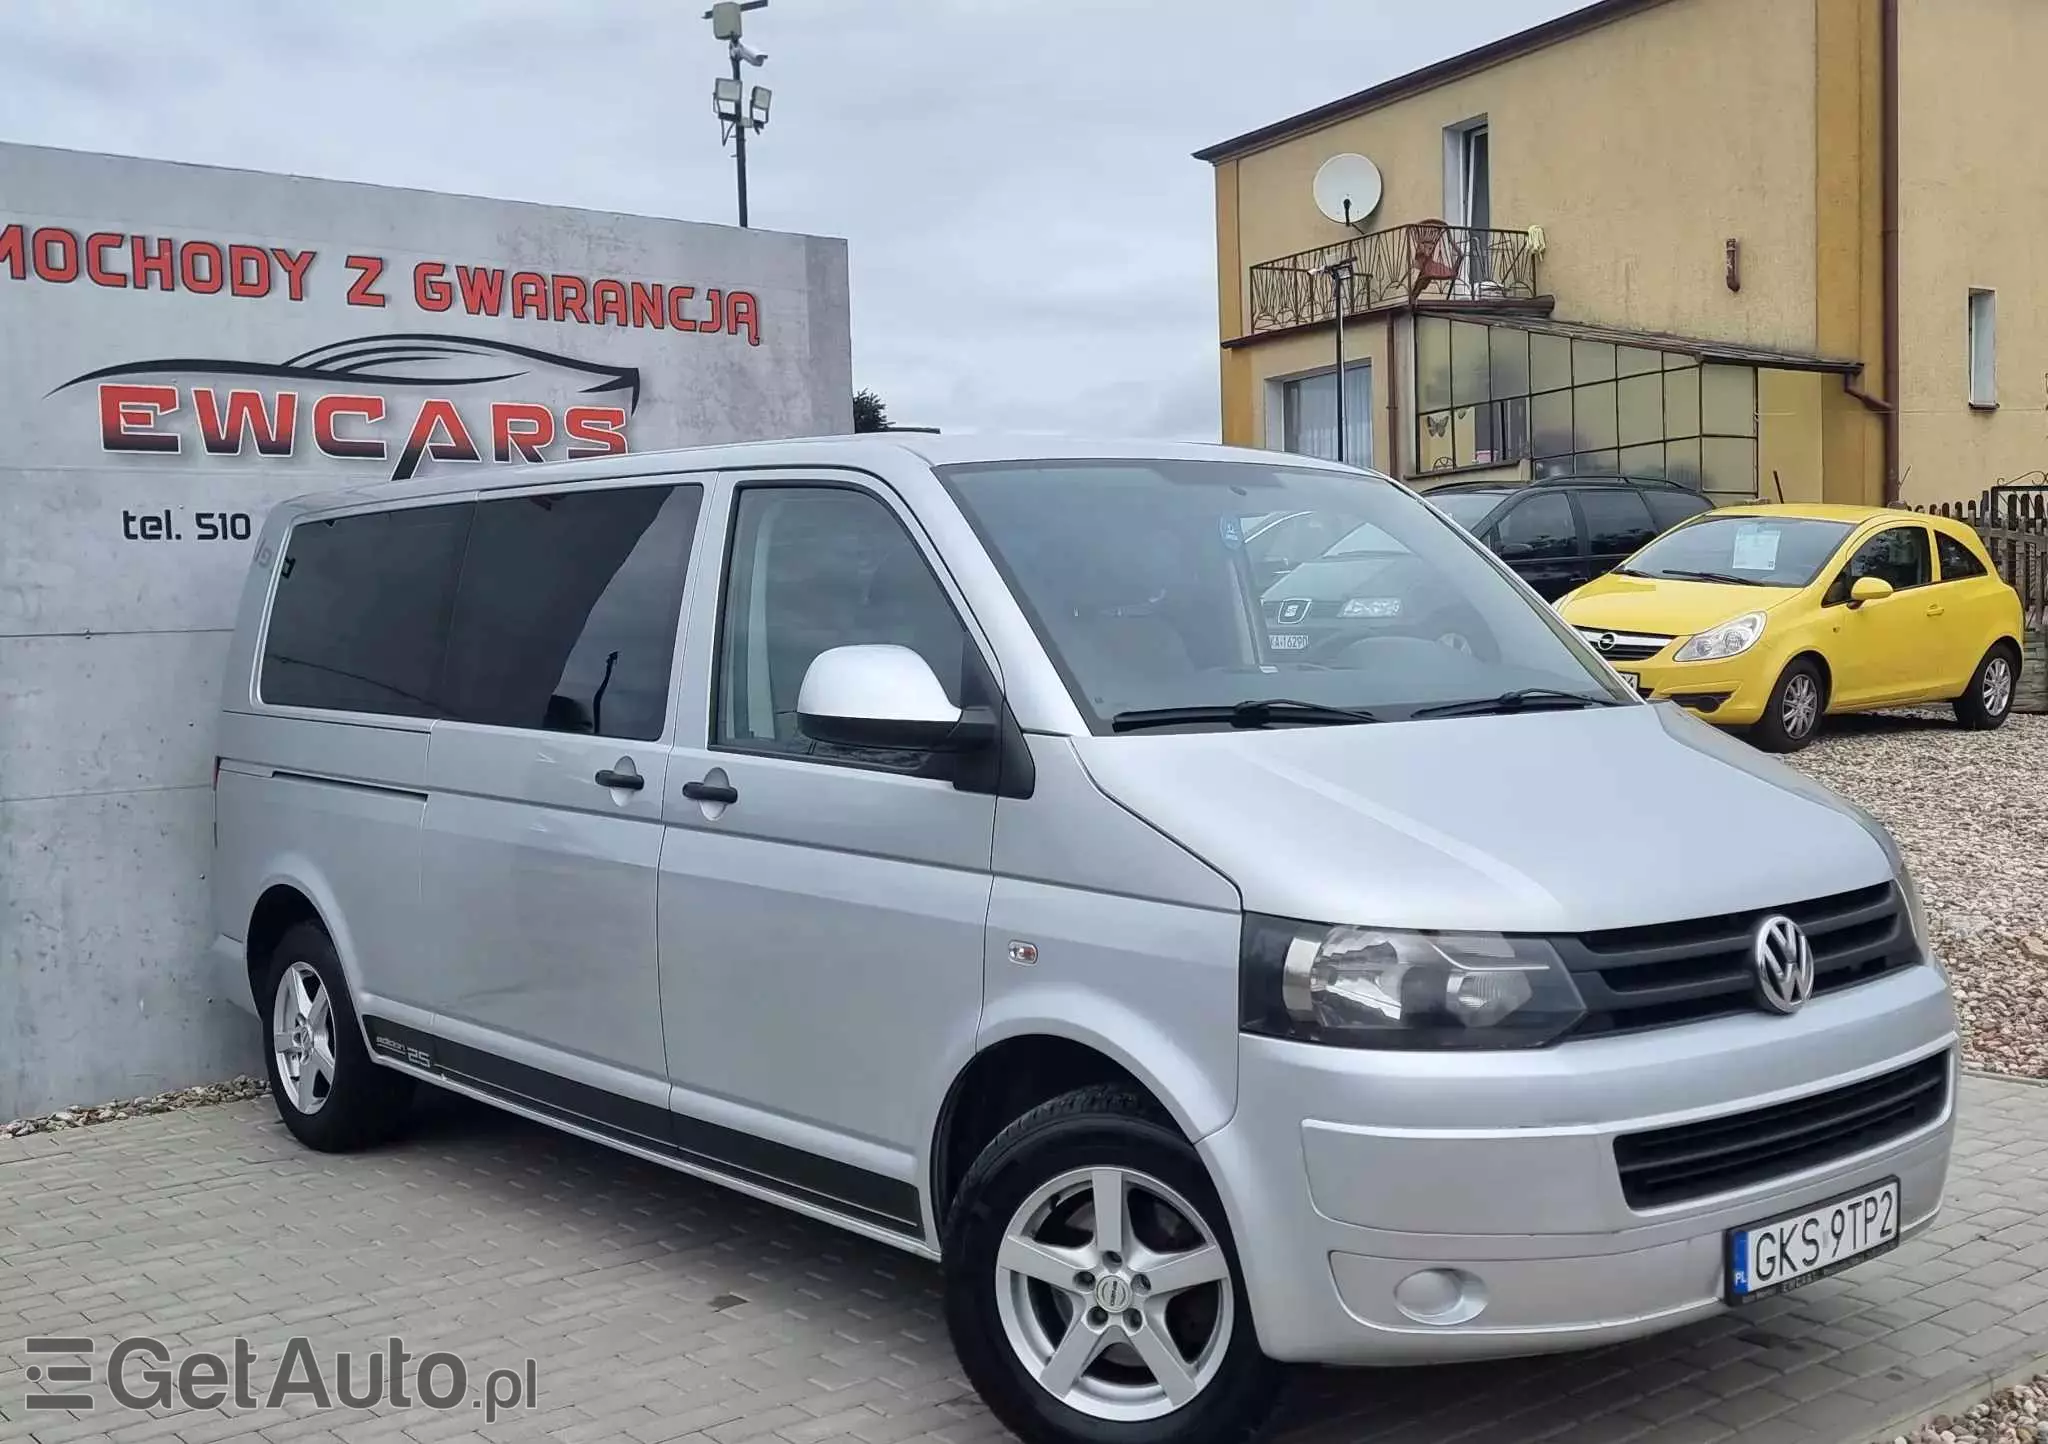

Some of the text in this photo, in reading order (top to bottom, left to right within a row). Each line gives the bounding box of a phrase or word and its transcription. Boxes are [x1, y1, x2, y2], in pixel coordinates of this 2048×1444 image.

[344, 255, 386, 308] Z
[413, 261, 761, 347] GWARANCJĄ
[98, 384, 629, 481] EWCARS
[122, 509, 251, 540] tel. 510
[407, 1047, 430, 1068] 25
[1755, 1218, 1821, 1281] GKS
[1829, 1190, 1893, 1258] 9TP2
[1734, 1270, 1748, 1286] PL
